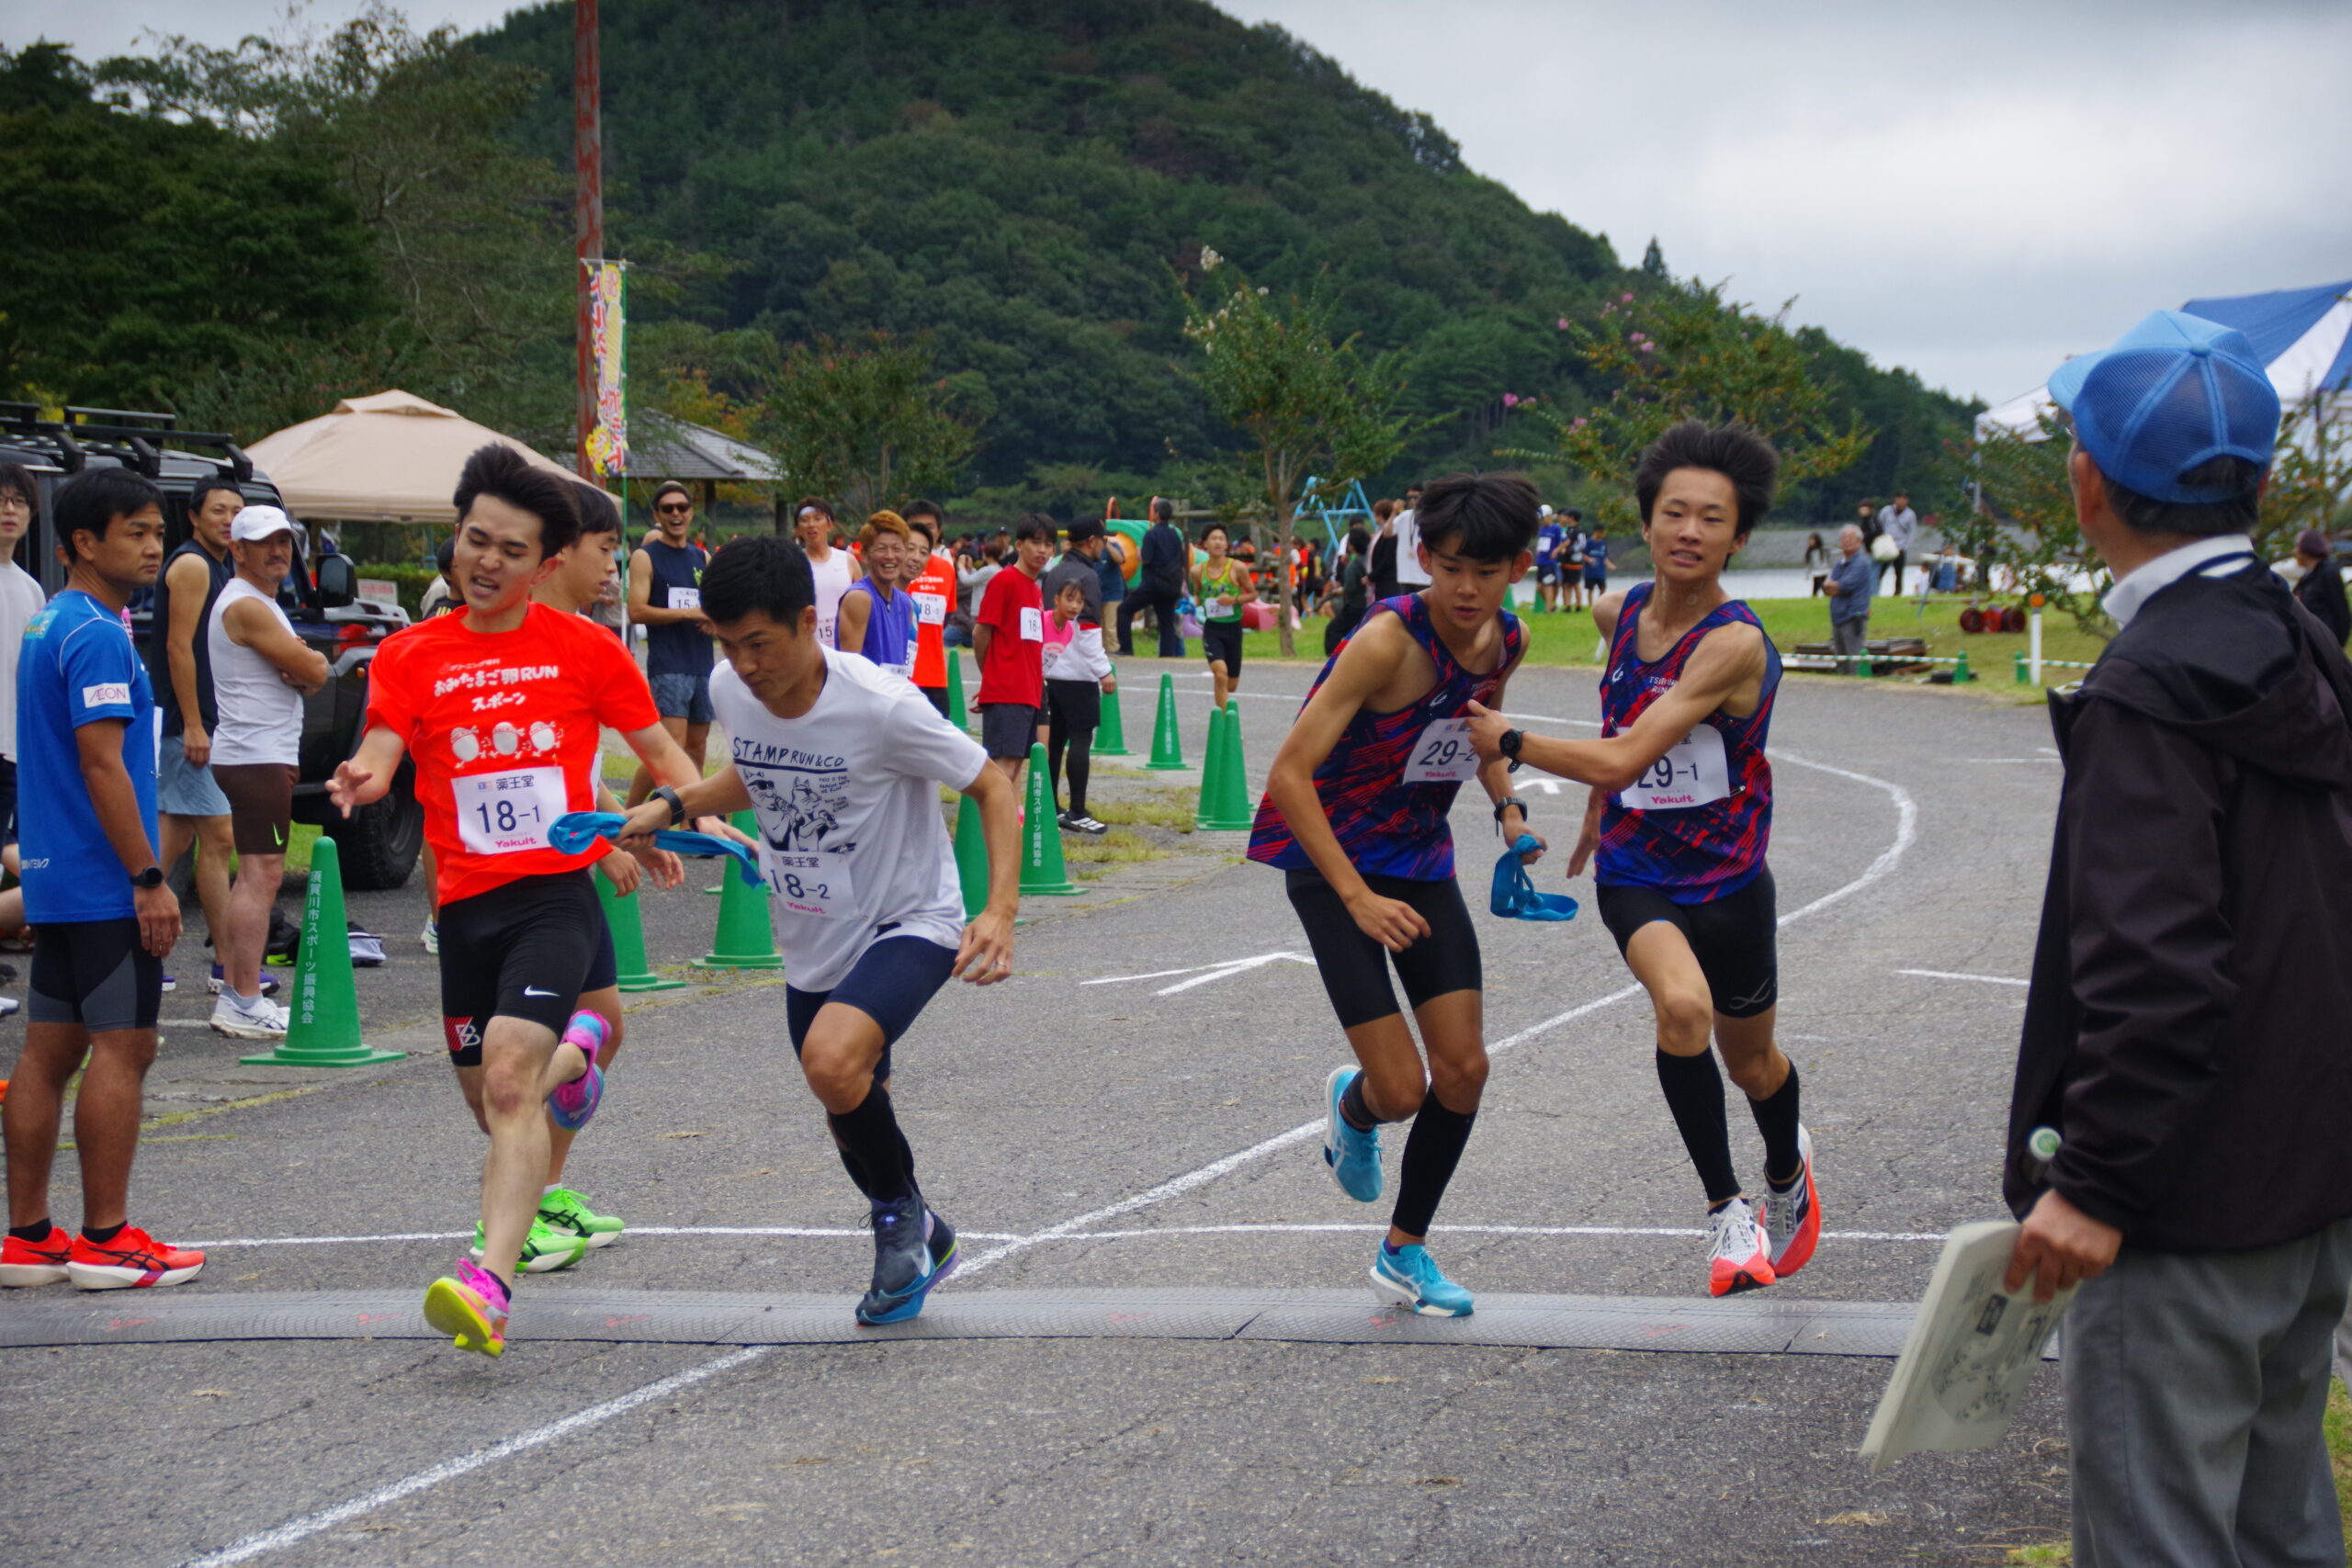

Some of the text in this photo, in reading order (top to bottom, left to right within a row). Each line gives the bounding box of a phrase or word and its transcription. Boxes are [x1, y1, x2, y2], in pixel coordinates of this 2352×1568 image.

[471, 691, 526, 712] スポーツ
[733, 737, 788, 764] STAMP
[495, 774, 535, 791] 薬王堂
[1652, 794, 1695, 805] Yakult
[476, 800, 540, 834] 18-1
[494, 837, 537, 848] Yakult
[781, 856, 820, 868] 薬王堂
[770, 868, 831, 900] 18-2
[301, 870, 322, 1024] 須賀川市スポーツ振興協会
